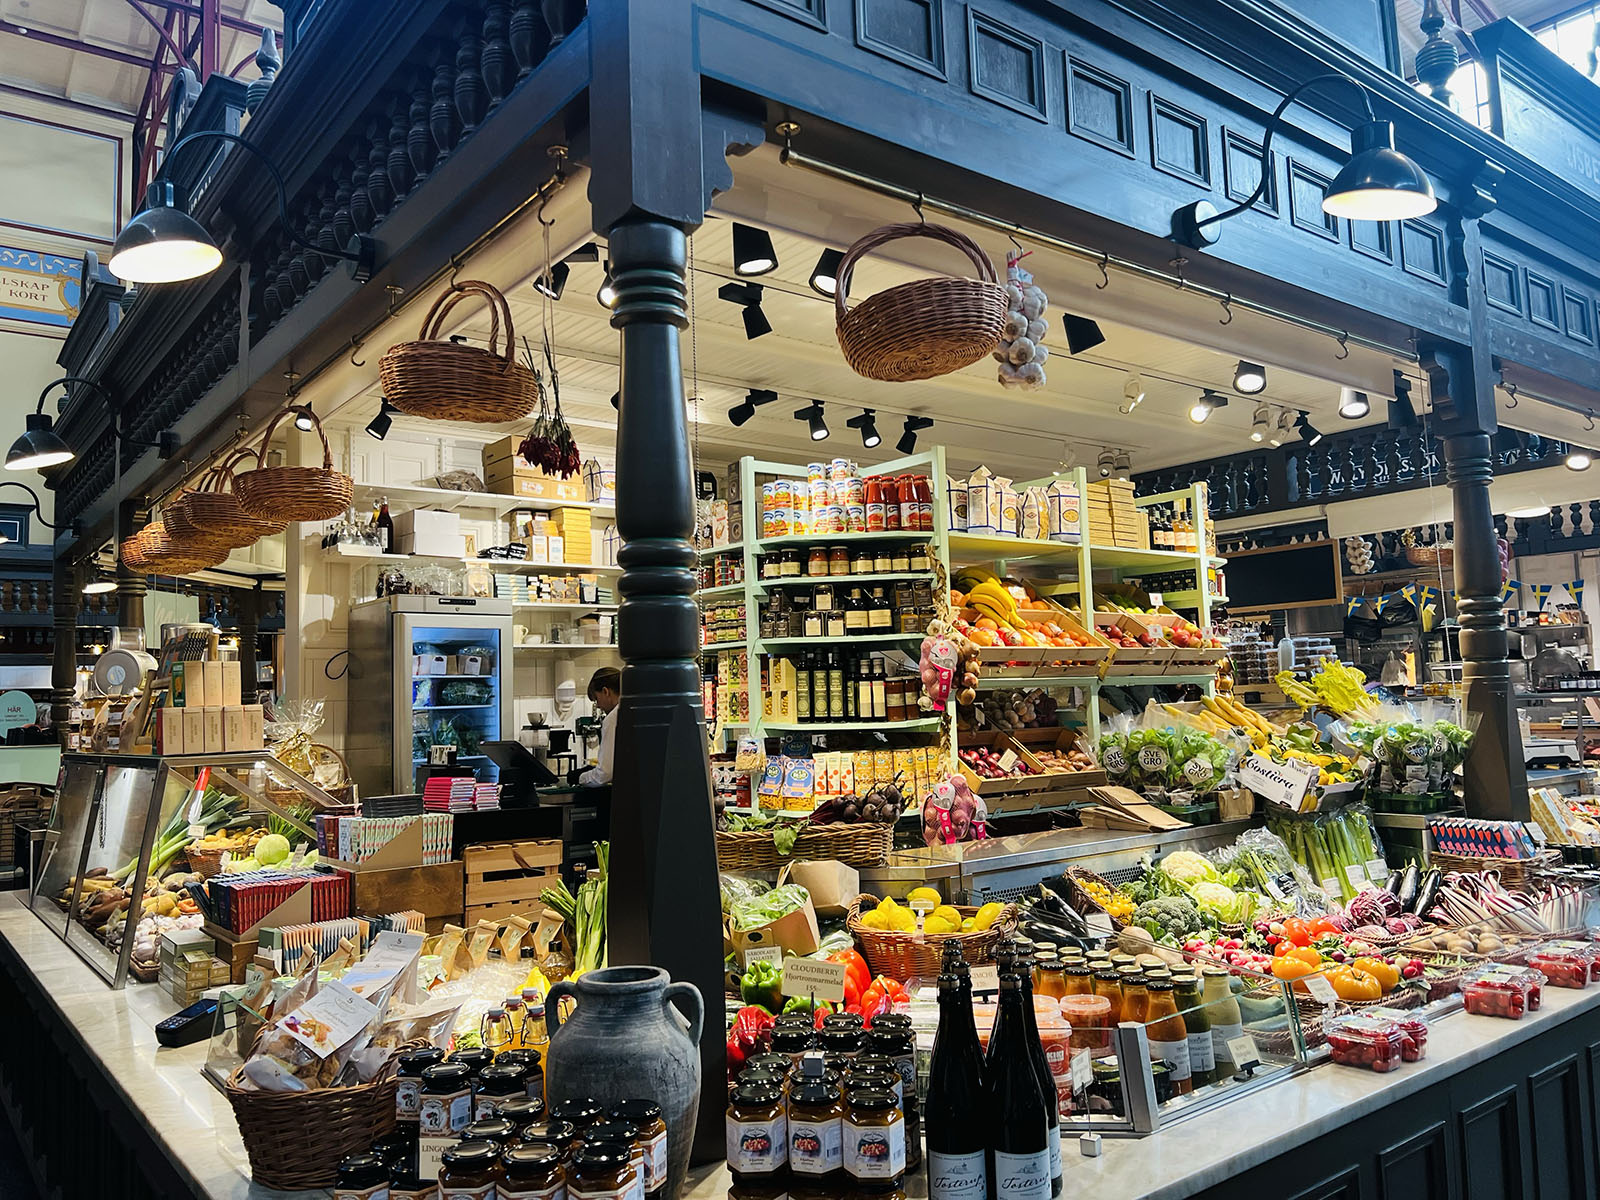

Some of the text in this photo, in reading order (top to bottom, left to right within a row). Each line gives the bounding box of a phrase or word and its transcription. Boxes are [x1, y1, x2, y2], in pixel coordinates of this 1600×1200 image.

[9, 289, 49, 302] KORT
[1106, 750, 1123, 761] SVE
[1143, 749, 1161, 758] SVE
[1143, 757, 1162, 767] GRO
[790, 963, 840, 976] CLOUDBERRY
[785, 972, 844, 986] Hjortronmarmelad
